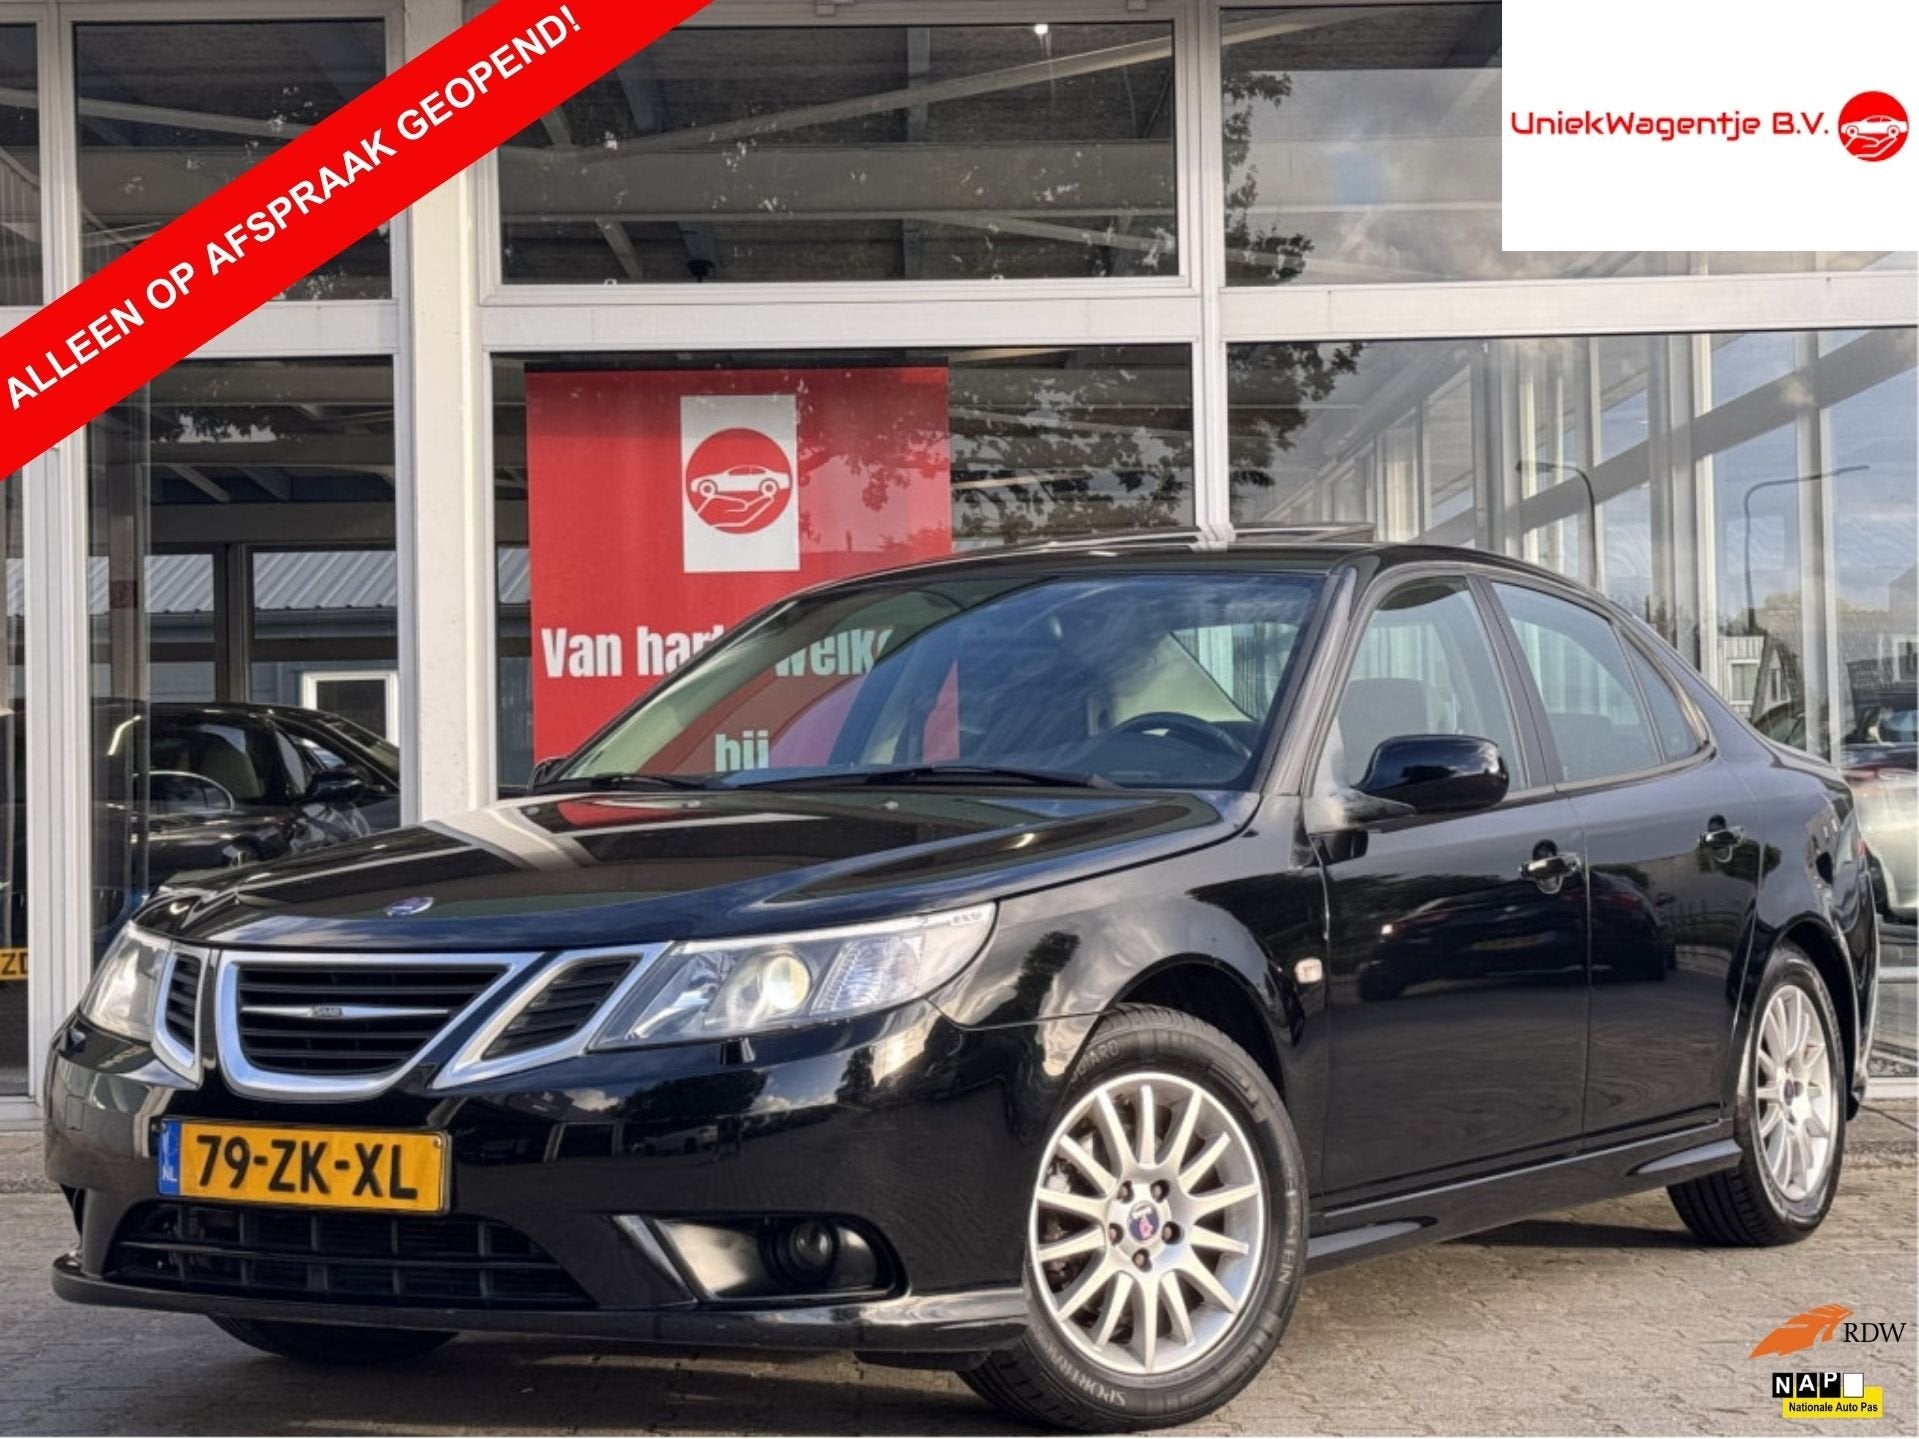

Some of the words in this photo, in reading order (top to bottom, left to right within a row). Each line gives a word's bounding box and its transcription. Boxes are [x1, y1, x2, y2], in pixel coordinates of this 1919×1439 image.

[541, 628, 622, 677] Van
[637, 625, 725, 677] har
[162, 1165, 178, 1183] NL
[196, 1134, 418, 1200] 79-ZK-XL
